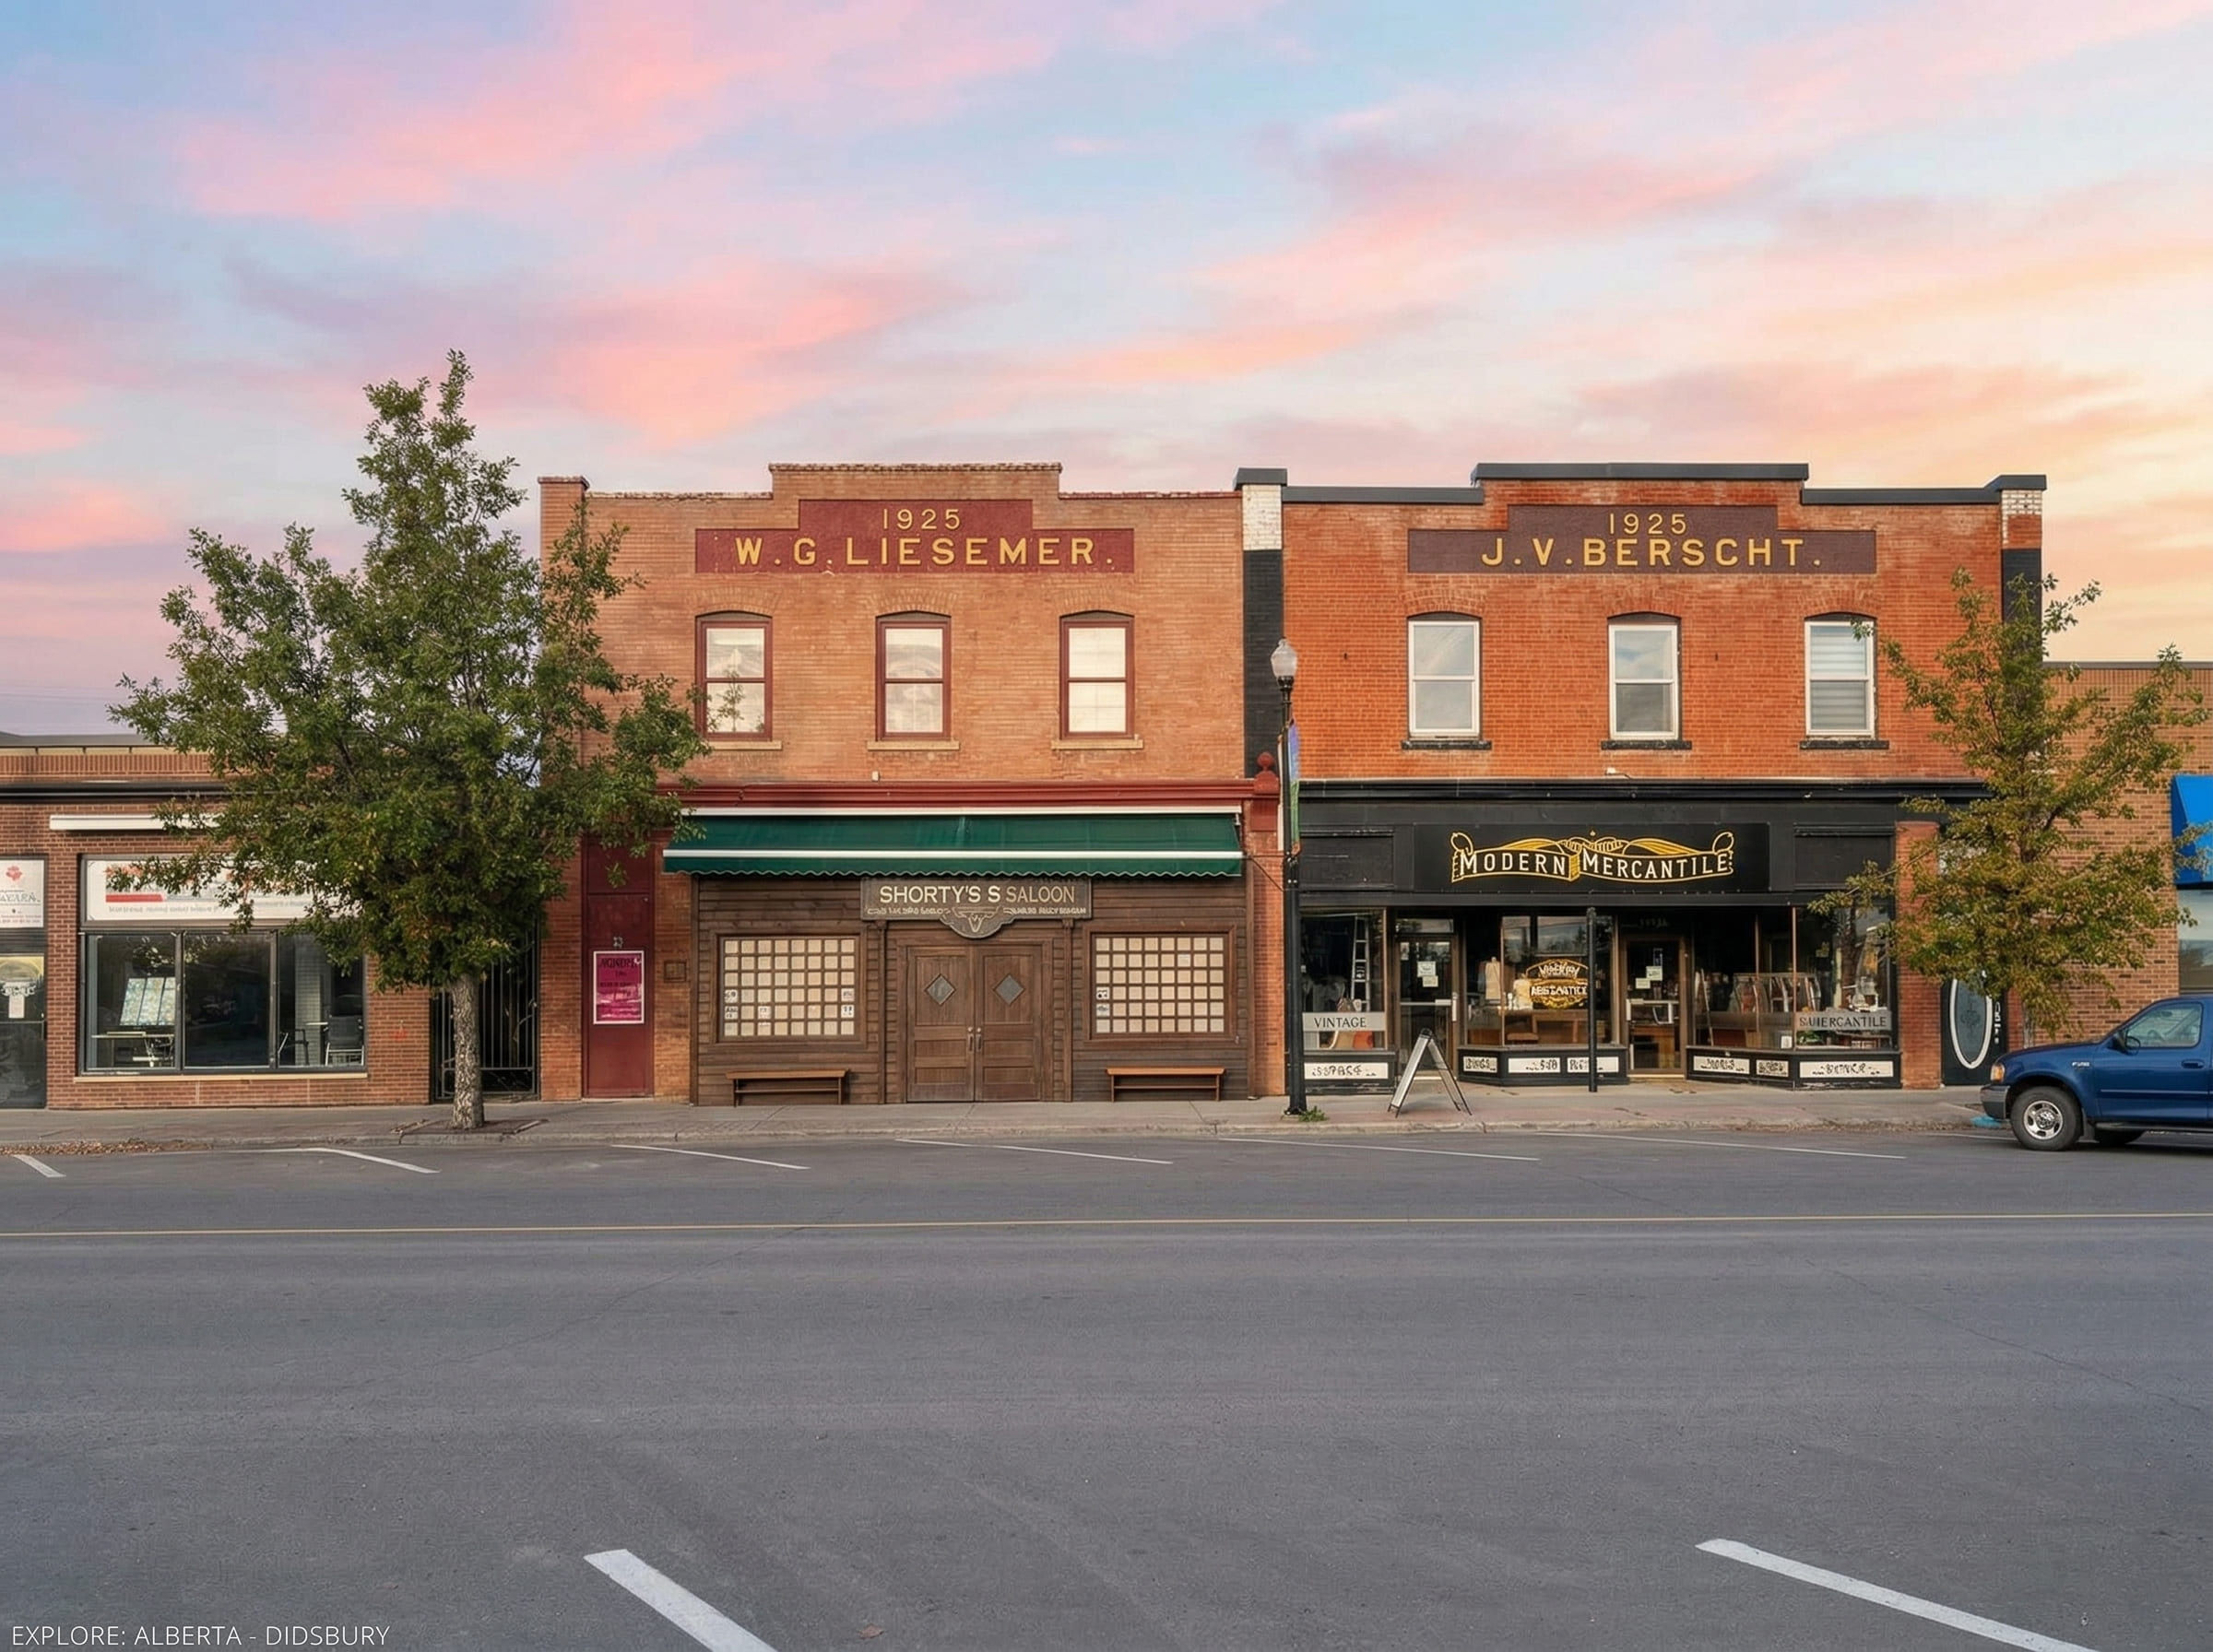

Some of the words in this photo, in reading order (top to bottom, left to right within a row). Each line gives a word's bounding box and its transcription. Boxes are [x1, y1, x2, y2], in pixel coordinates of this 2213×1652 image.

[882, 508, 961, 530] 1925
[1609, 513, 1687, 535] 1925
[1459, 850, 1567, 876] MODERN
[1582, 847, 1731, 879] MERCANTILE
[879, 885, 982, 904] SHORTY'S
[1005, 885, 1075, 904] SALOON
[1314, 1017, 1367, 1028] VINTAGE
